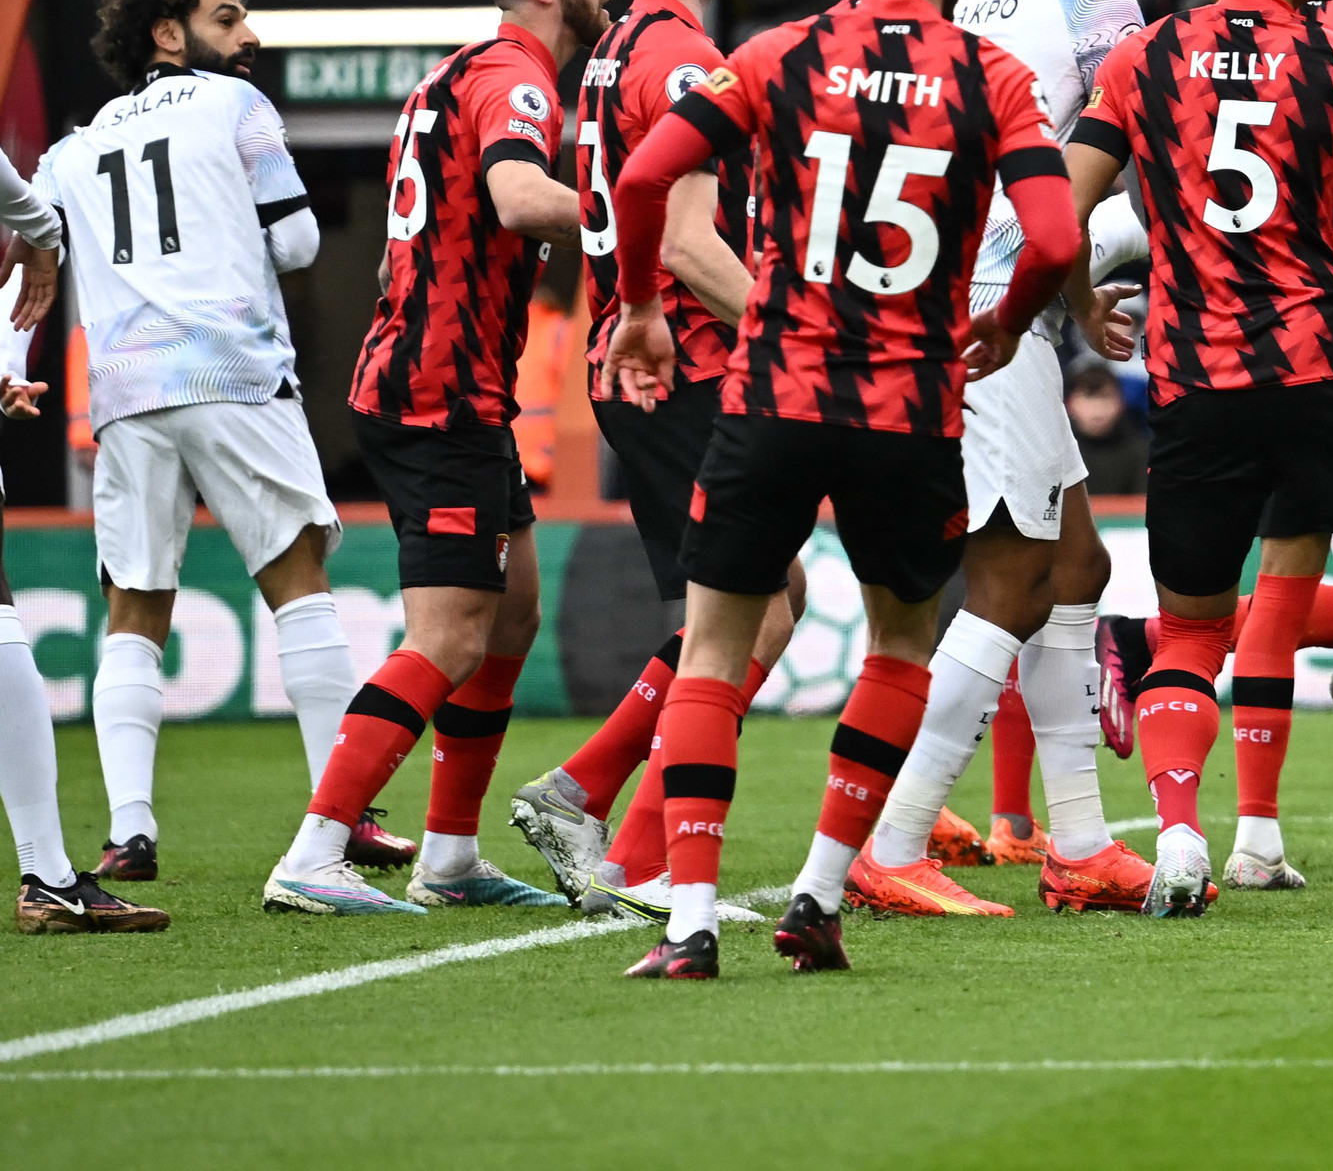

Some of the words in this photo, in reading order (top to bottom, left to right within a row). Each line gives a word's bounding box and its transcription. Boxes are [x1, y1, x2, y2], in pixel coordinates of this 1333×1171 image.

[286, 51, 377, 99] EXIT
[826, 66, 942, 107] SMITH
[1189, 50, 1286, 81] KELLY
[111, 85, 196, 127] SALAH
[1202, 100, 1278, 234] 5
[97, 137, 181, 265] 11
[803, 130, 954, 296] 15
[632, 679, 657, 702] FCB
[1139, 701, 1198, 721] AFCB
